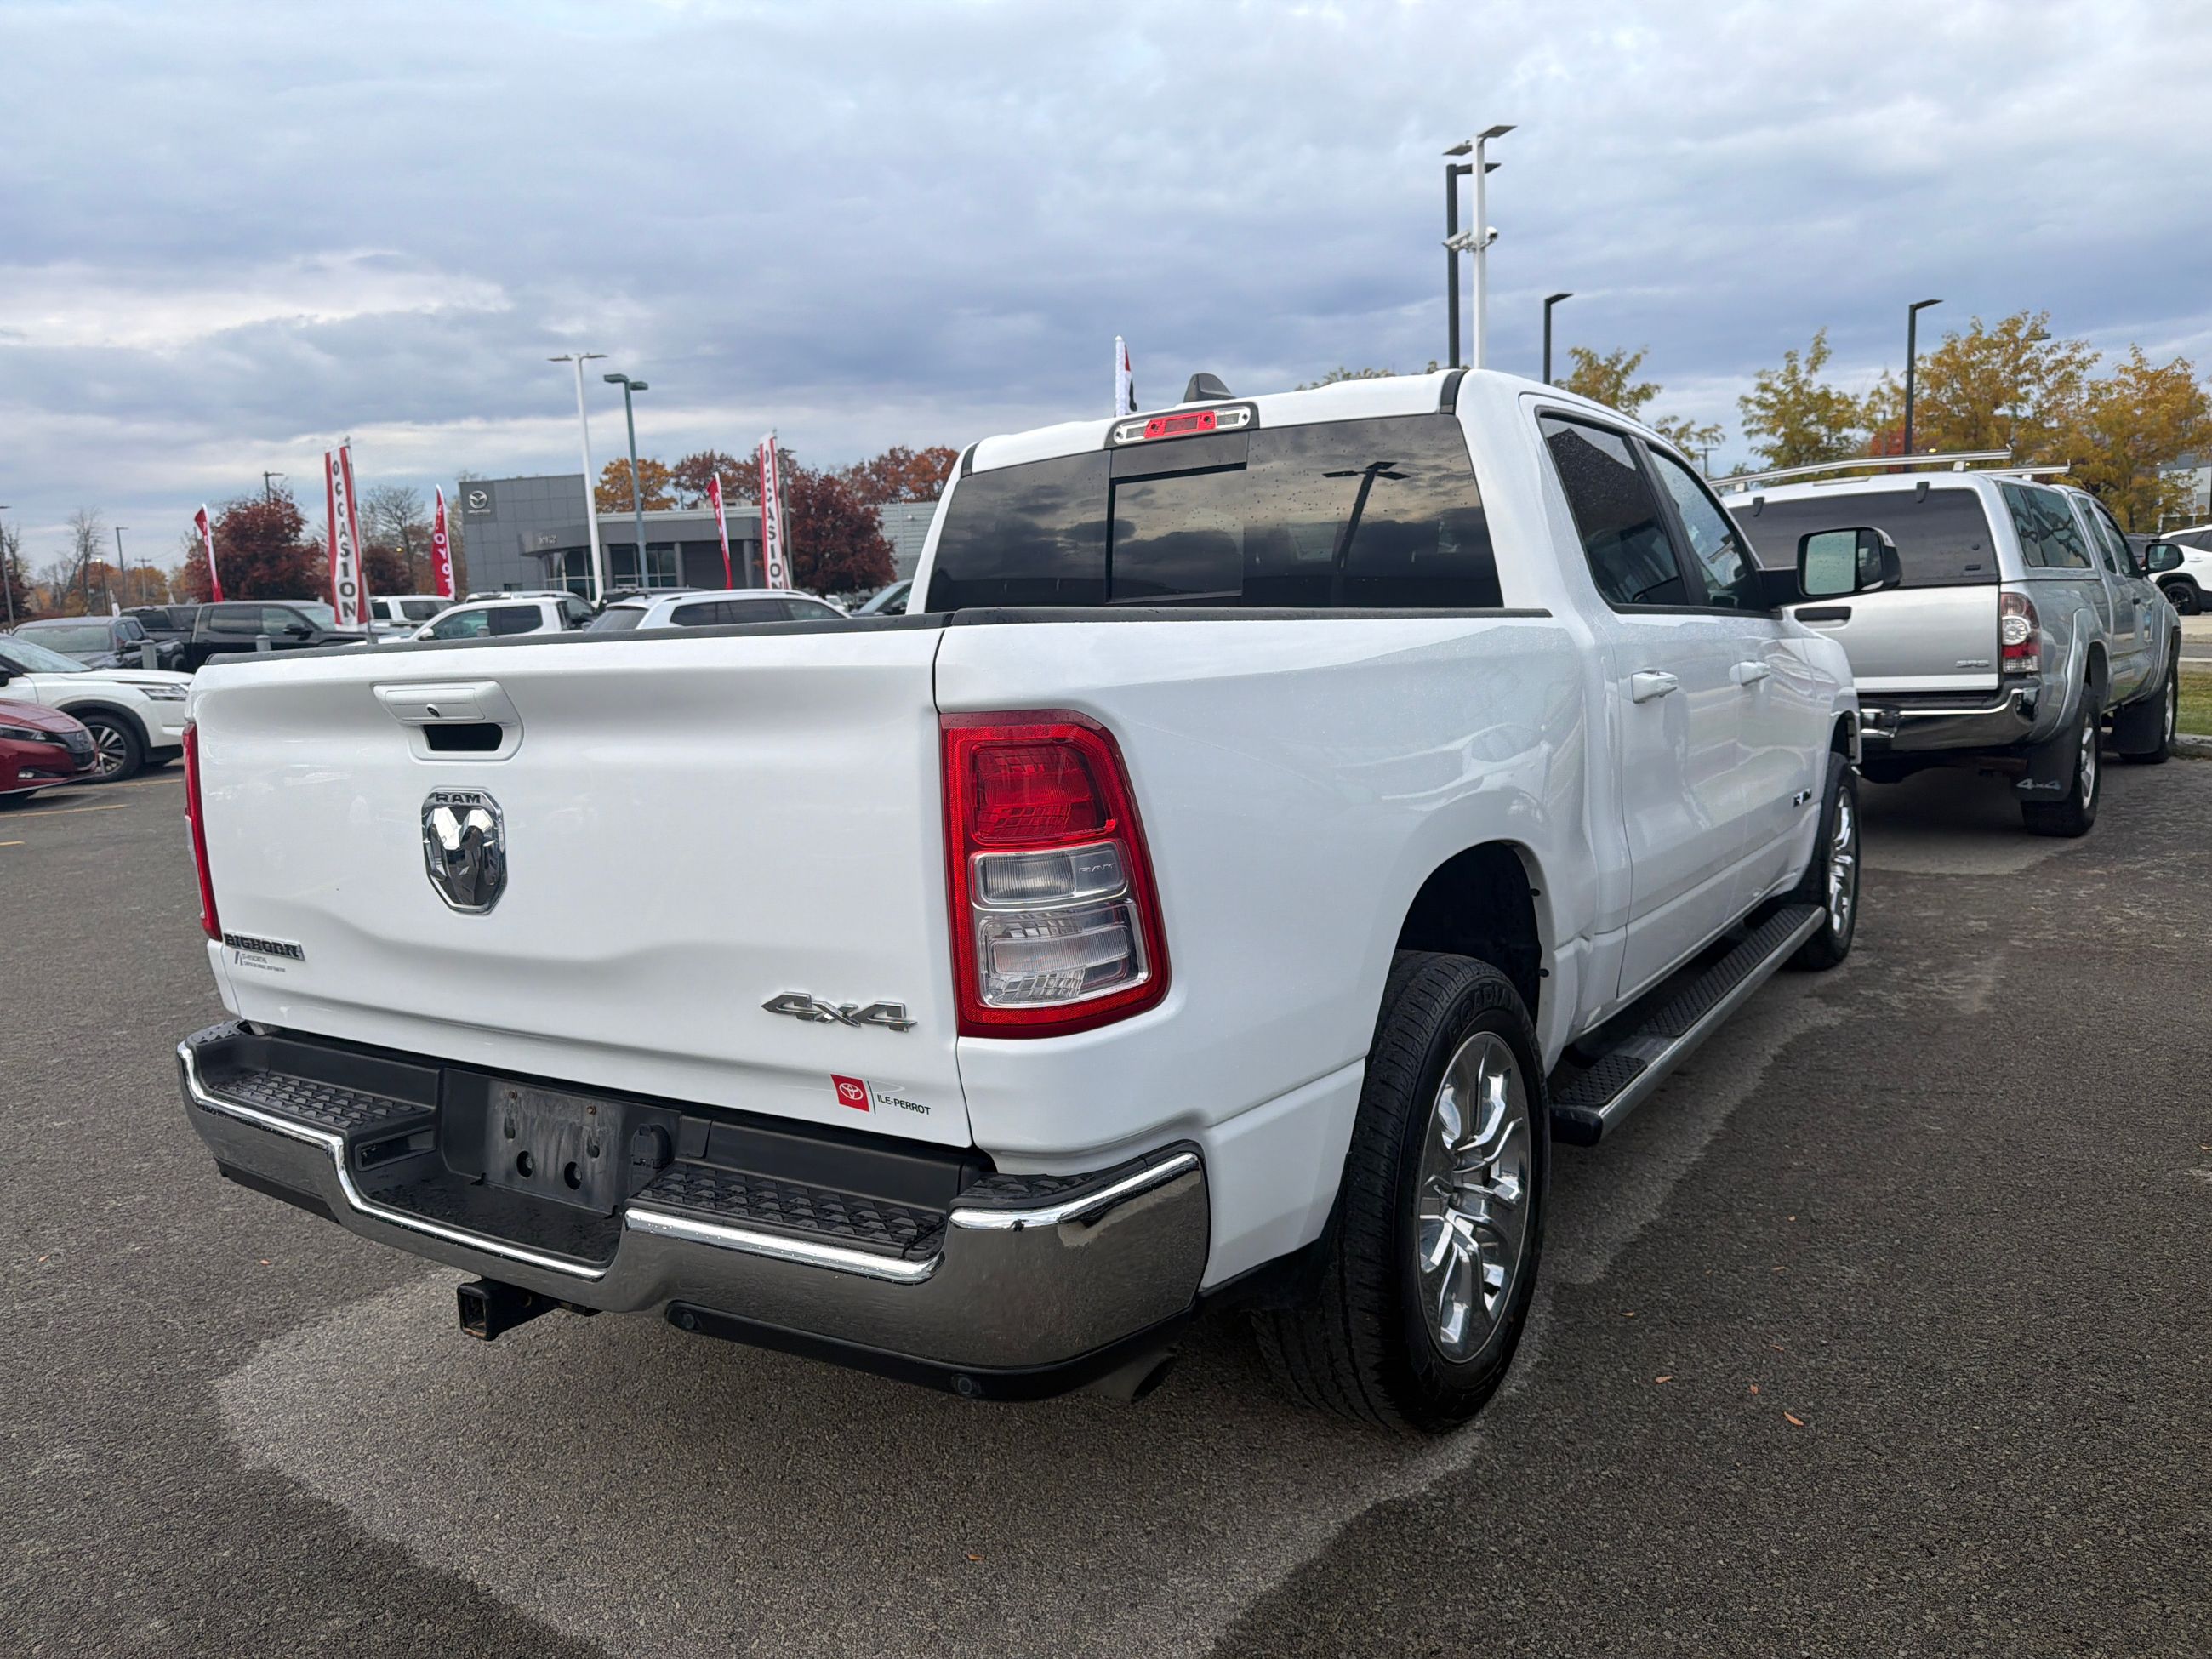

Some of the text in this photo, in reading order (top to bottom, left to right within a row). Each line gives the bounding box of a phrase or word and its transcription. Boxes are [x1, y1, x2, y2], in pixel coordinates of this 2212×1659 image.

[332, 460, 356, 618] OCCASION
[435, 793, 482, 804] RAM
[224, 932, 305, 961] BIGHORN
[877, 1094, 932, 1115] ILE-PERROT
